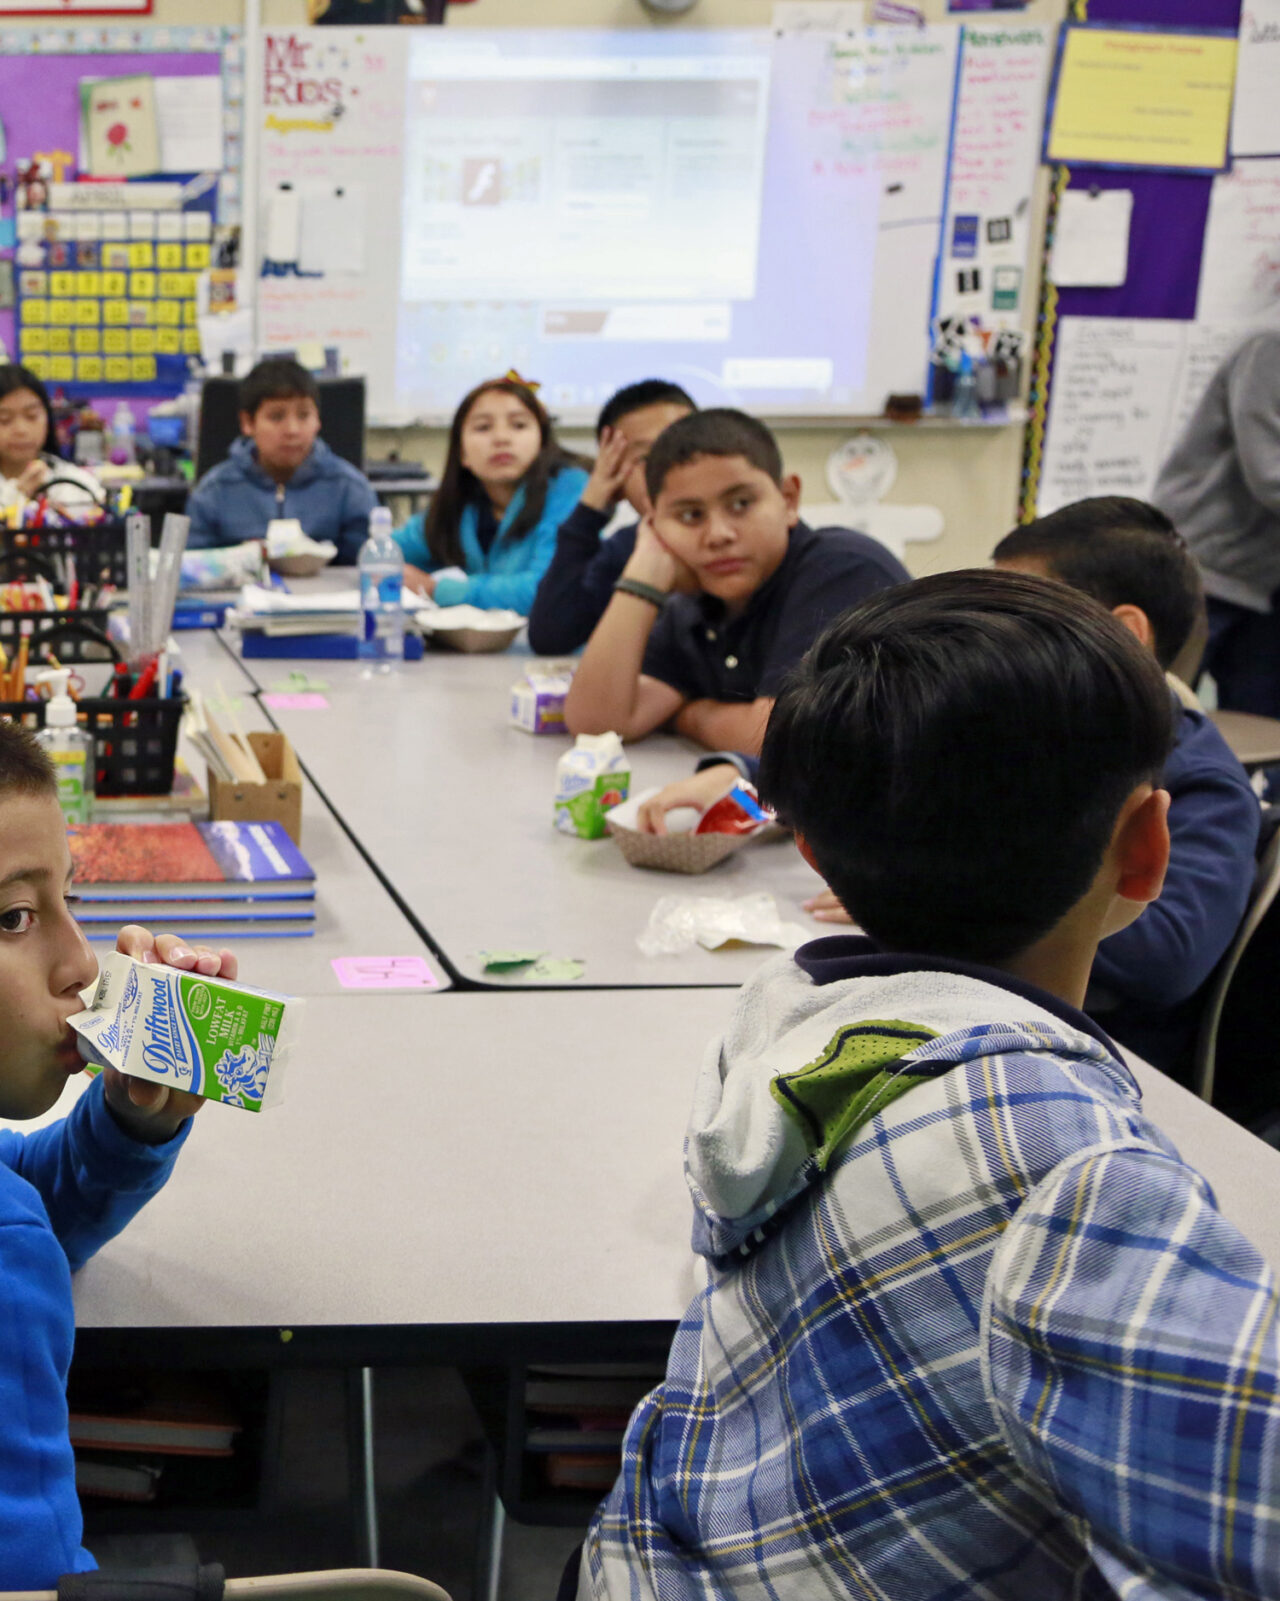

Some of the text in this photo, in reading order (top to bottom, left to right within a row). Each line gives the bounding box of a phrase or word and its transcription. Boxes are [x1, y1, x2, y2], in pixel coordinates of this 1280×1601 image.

[142, 978, 179, 1077] Driftwood
[206, 995, 227, 1045] LOWFAT
[219, 1009, 235, 1038] MILK
[228, 1022, 239, 1047] VITAMIN
[237, 1009, 249, 1036] MILKFAT
